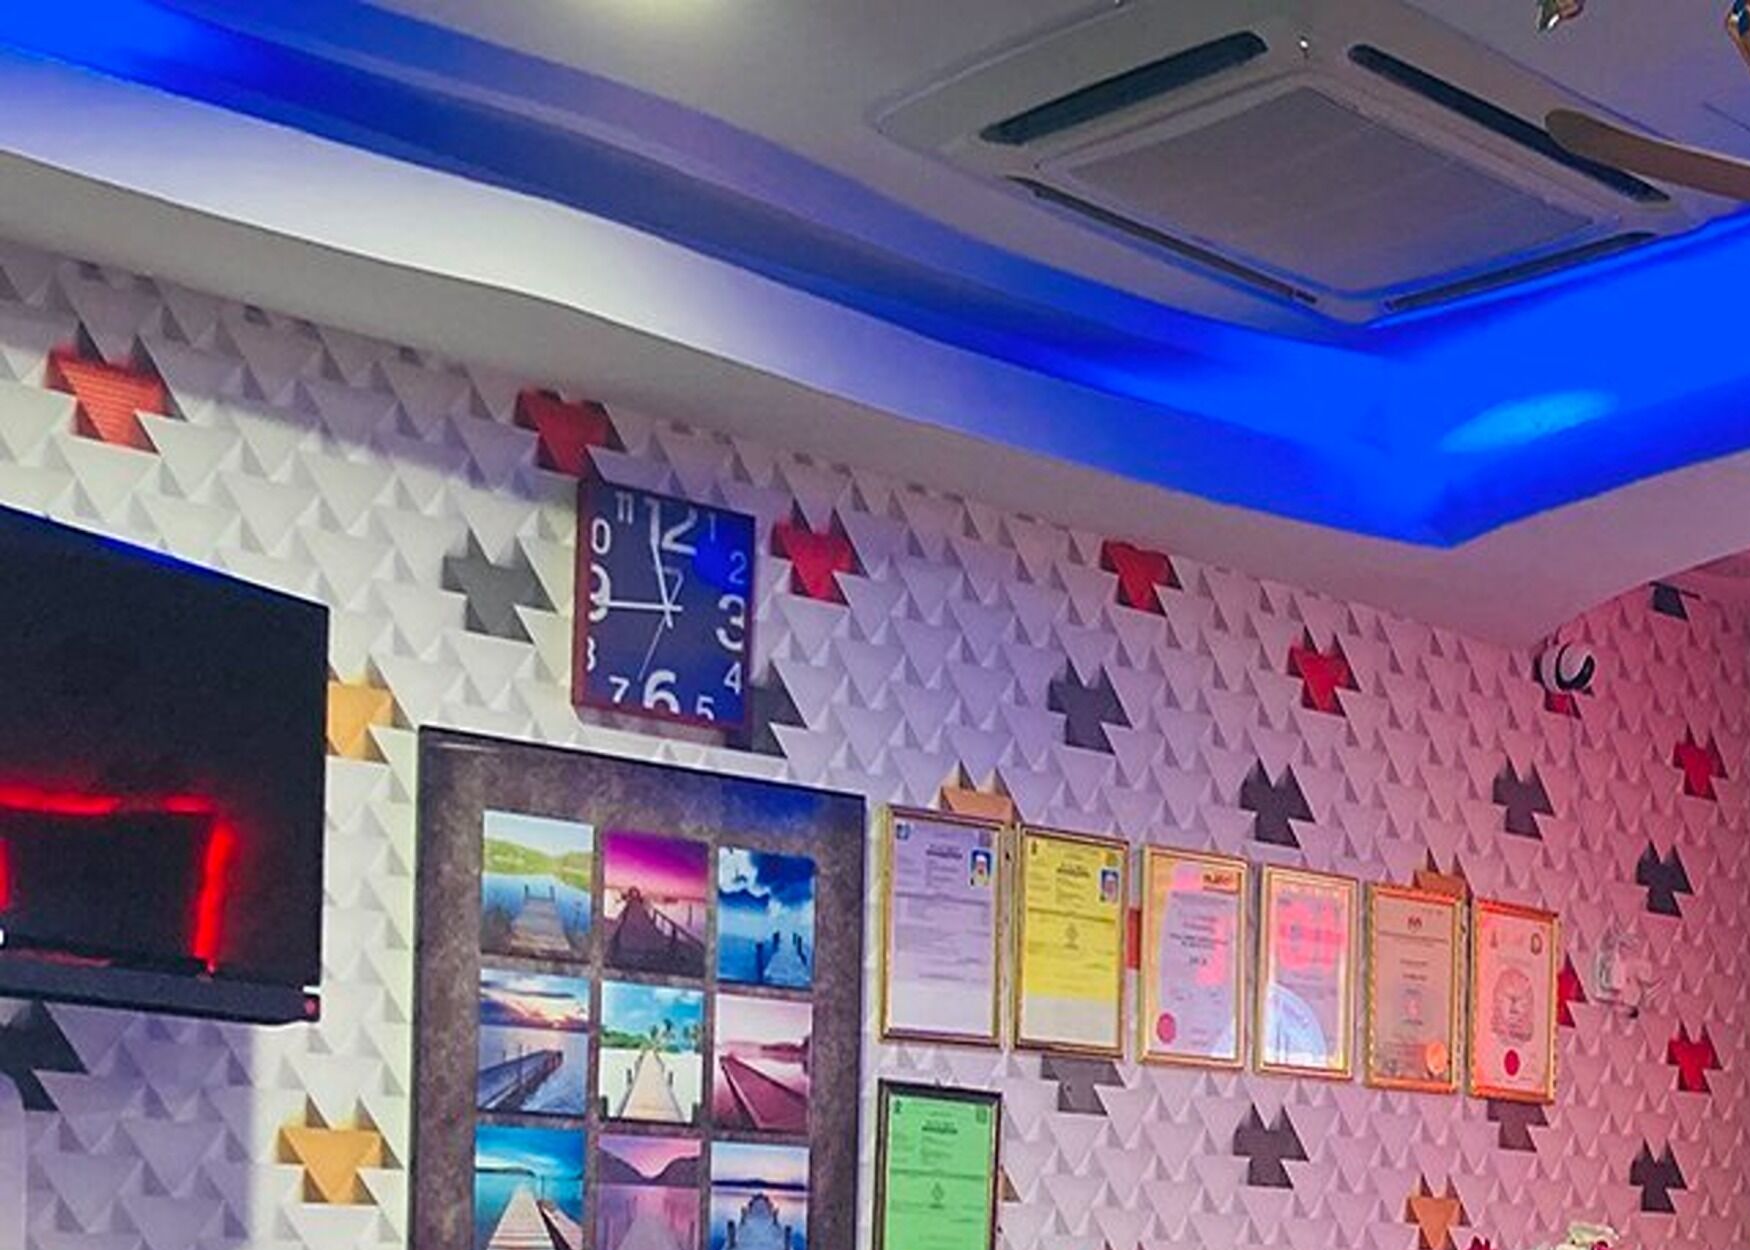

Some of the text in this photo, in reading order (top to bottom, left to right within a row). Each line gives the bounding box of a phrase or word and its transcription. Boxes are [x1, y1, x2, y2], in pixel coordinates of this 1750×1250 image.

[644, 498, 699, 556] 12
[728, 551, 747, 585] 2
[715, 594, 746, 650] 3
[608, 676, 630, 704] 7
[723, 661, 743, 695] 4
